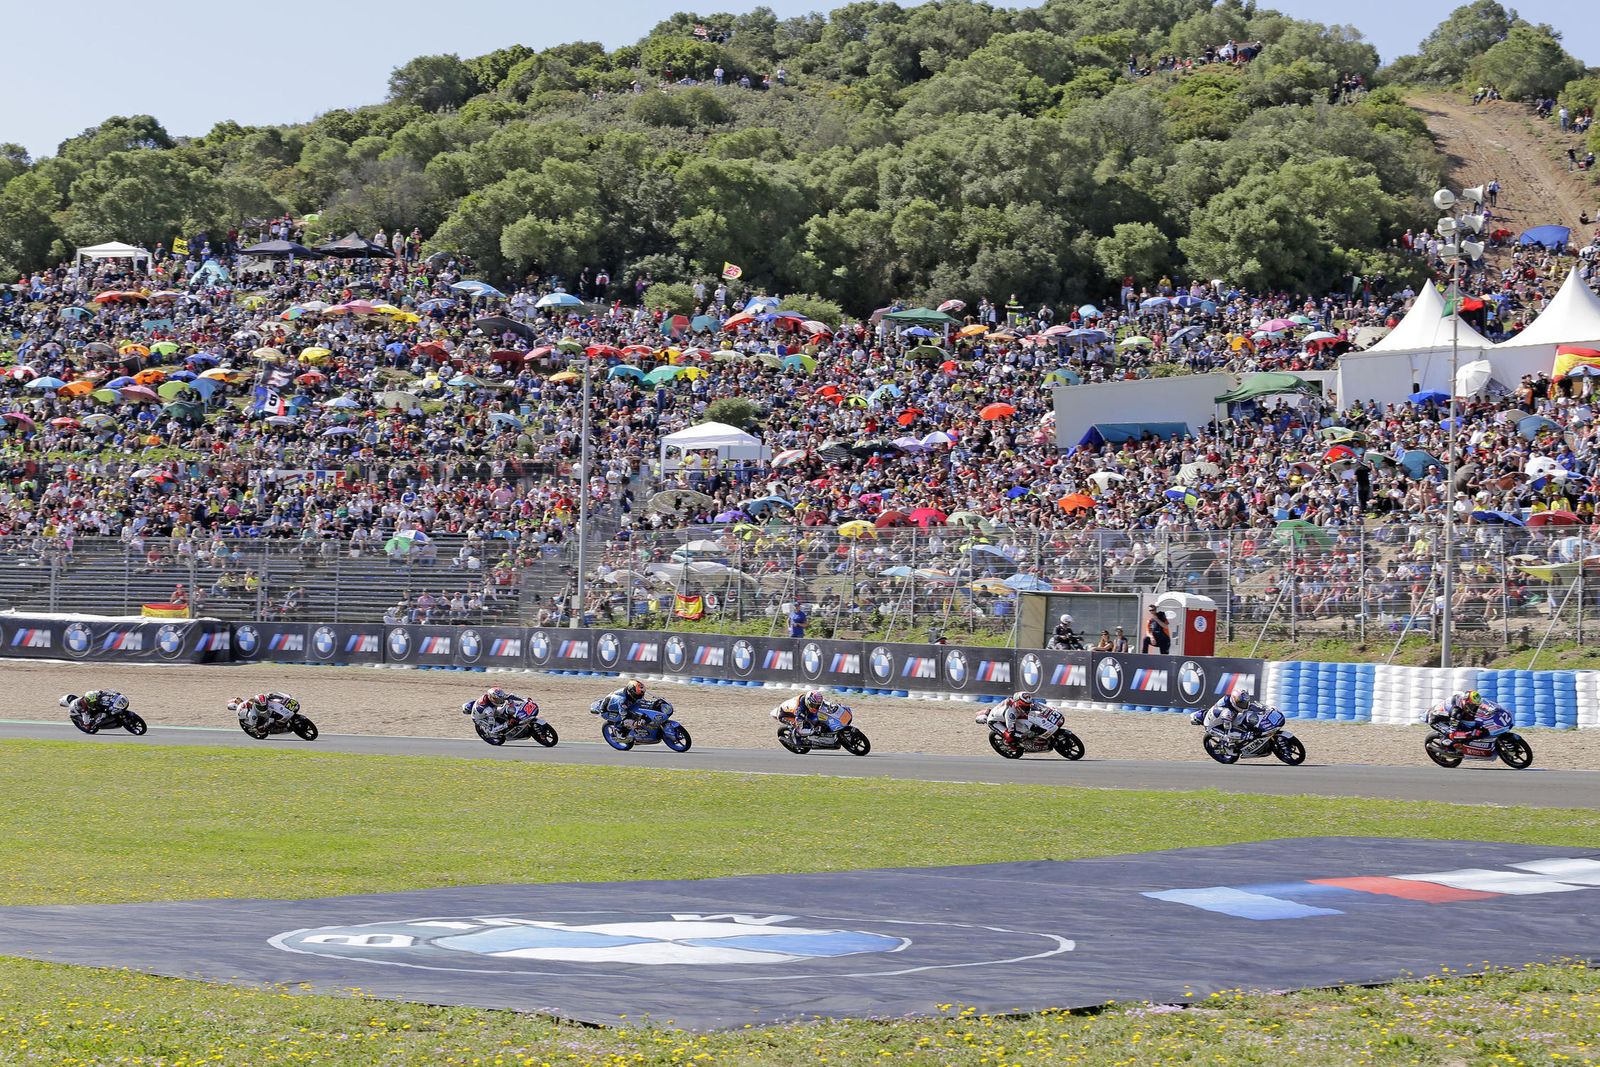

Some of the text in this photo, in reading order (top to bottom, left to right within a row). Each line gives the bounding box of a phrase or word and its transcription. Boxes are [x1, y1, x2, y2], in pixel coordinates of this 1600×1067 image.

[268, 394, 278, 406] 5
[1048, 710, 1061, 724] 23
[1499, 712, 1511, 727] 12
